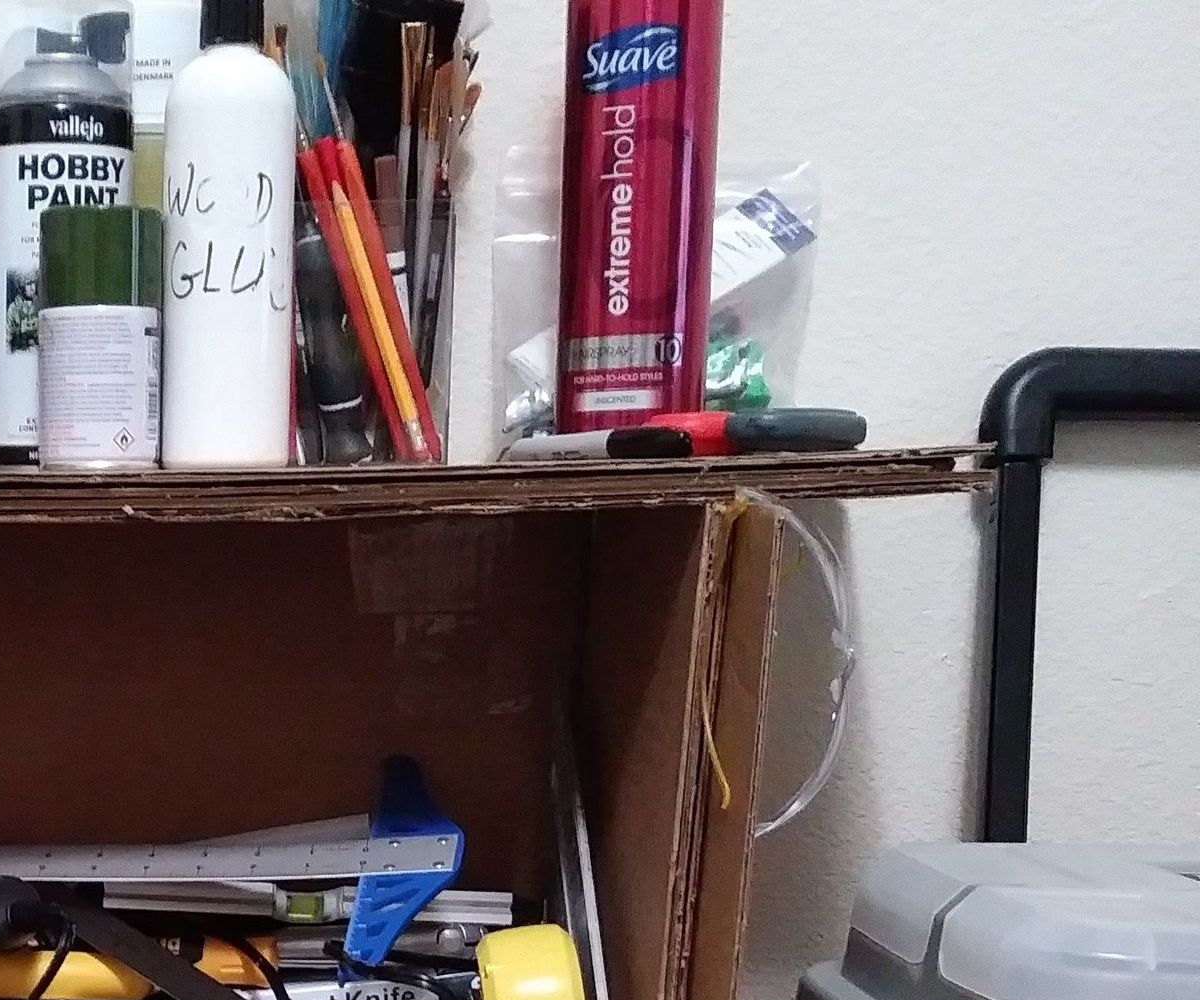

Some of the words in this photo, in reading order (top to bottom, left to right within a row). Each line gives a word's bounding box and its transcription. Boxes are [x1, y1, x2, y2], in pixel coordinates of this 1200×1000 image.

[135, 59, 159, 67] MADE
[161, 59, 171, 67] IN
[582, 40, 678, 80] Suave
[133, 72, 174, 81] DENMARK
[49, 114, 105, 142] vallejo
[600, 104, 636, 179] hold
[17, 152, 126, 184] HOBBY
[27, 183, 120, 211] PAINT
[604, 183, 634, 316] extreme
